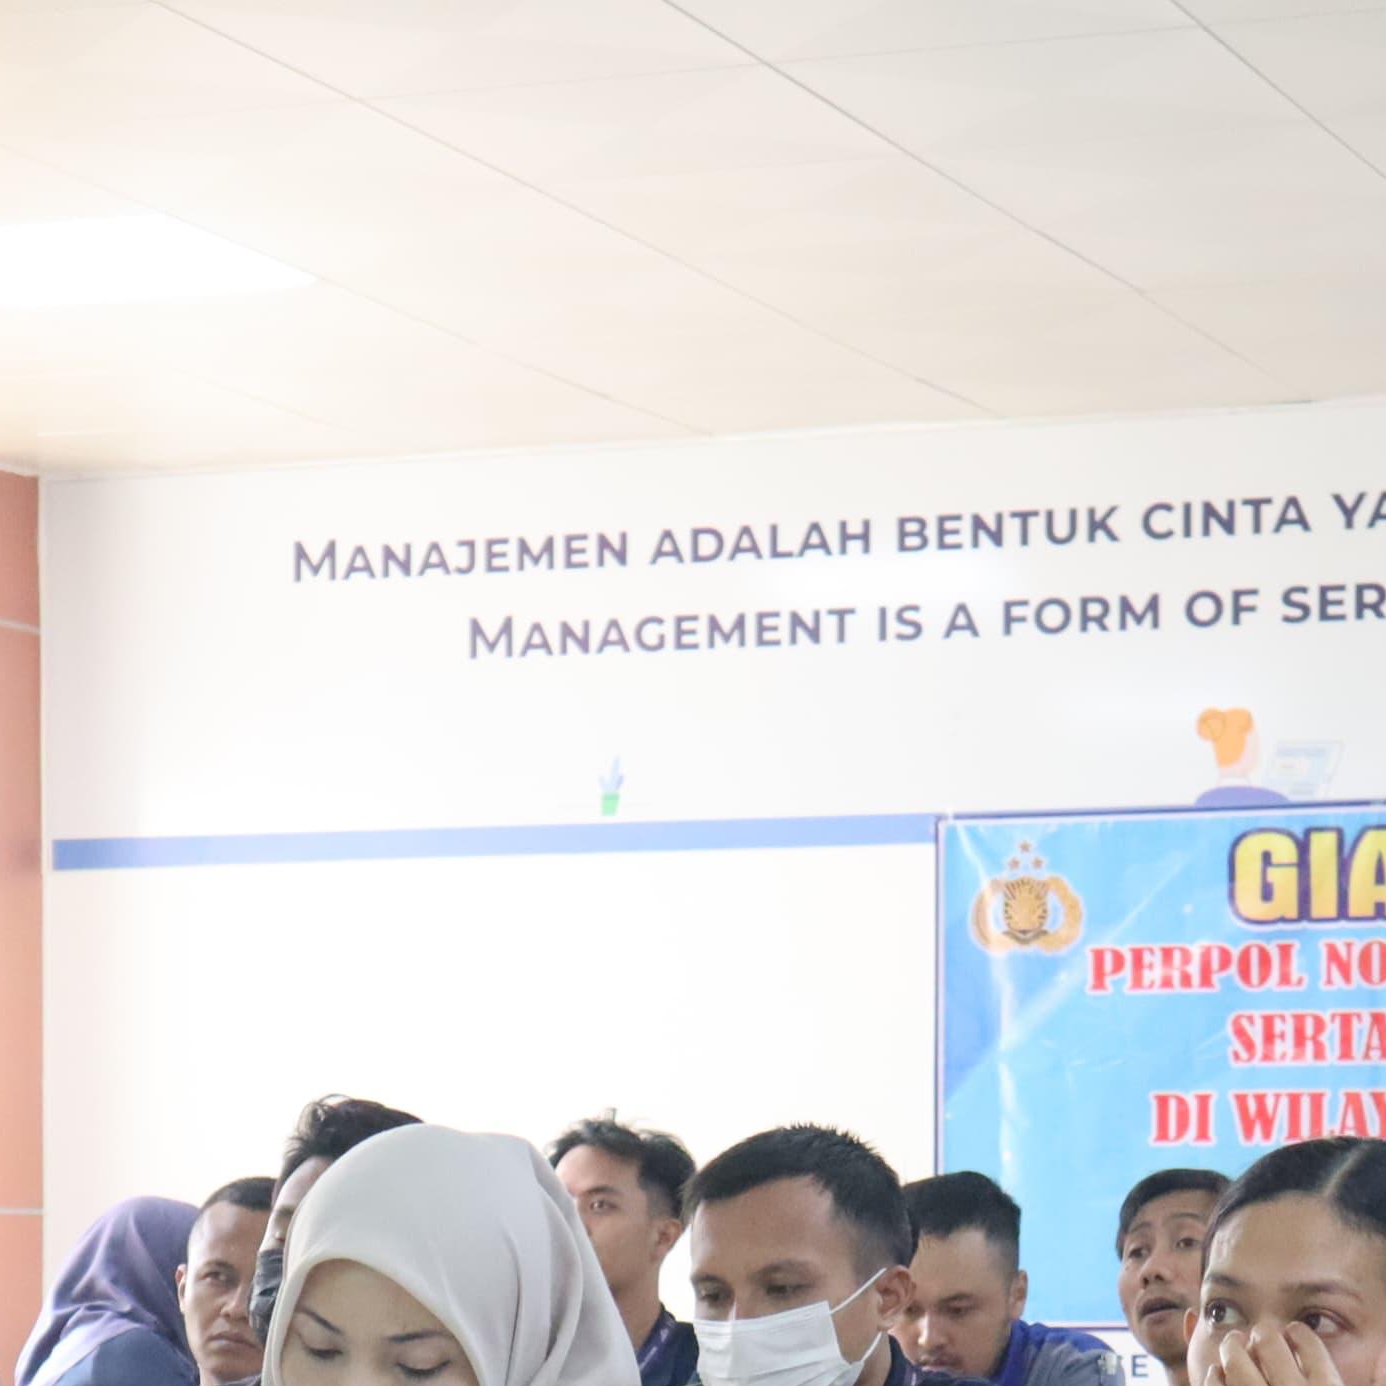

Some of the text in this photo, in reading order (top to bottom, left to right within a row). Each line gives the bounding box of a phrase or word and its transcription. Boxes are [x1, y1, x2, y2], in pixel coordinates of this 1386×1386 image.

[294, 531, 628, 583] MANAJEMEN
[649, 518, 871, 566] ADALAH
[896, 505, 1121, 553] BENTUK
[1141, 495, 1312, 541] CINTA
[469, 607, 857, 660] MANAGEMENT
[878, 604, 923, 642] IS
[943, 602, 980, 639] A
[1002, 592, 1160, 637] FORM
[1184, 587, 1260, 629] OF
[1089, 943, 1303, 991] PERPOL
[1153, 1093, 1214, 1142] DI
